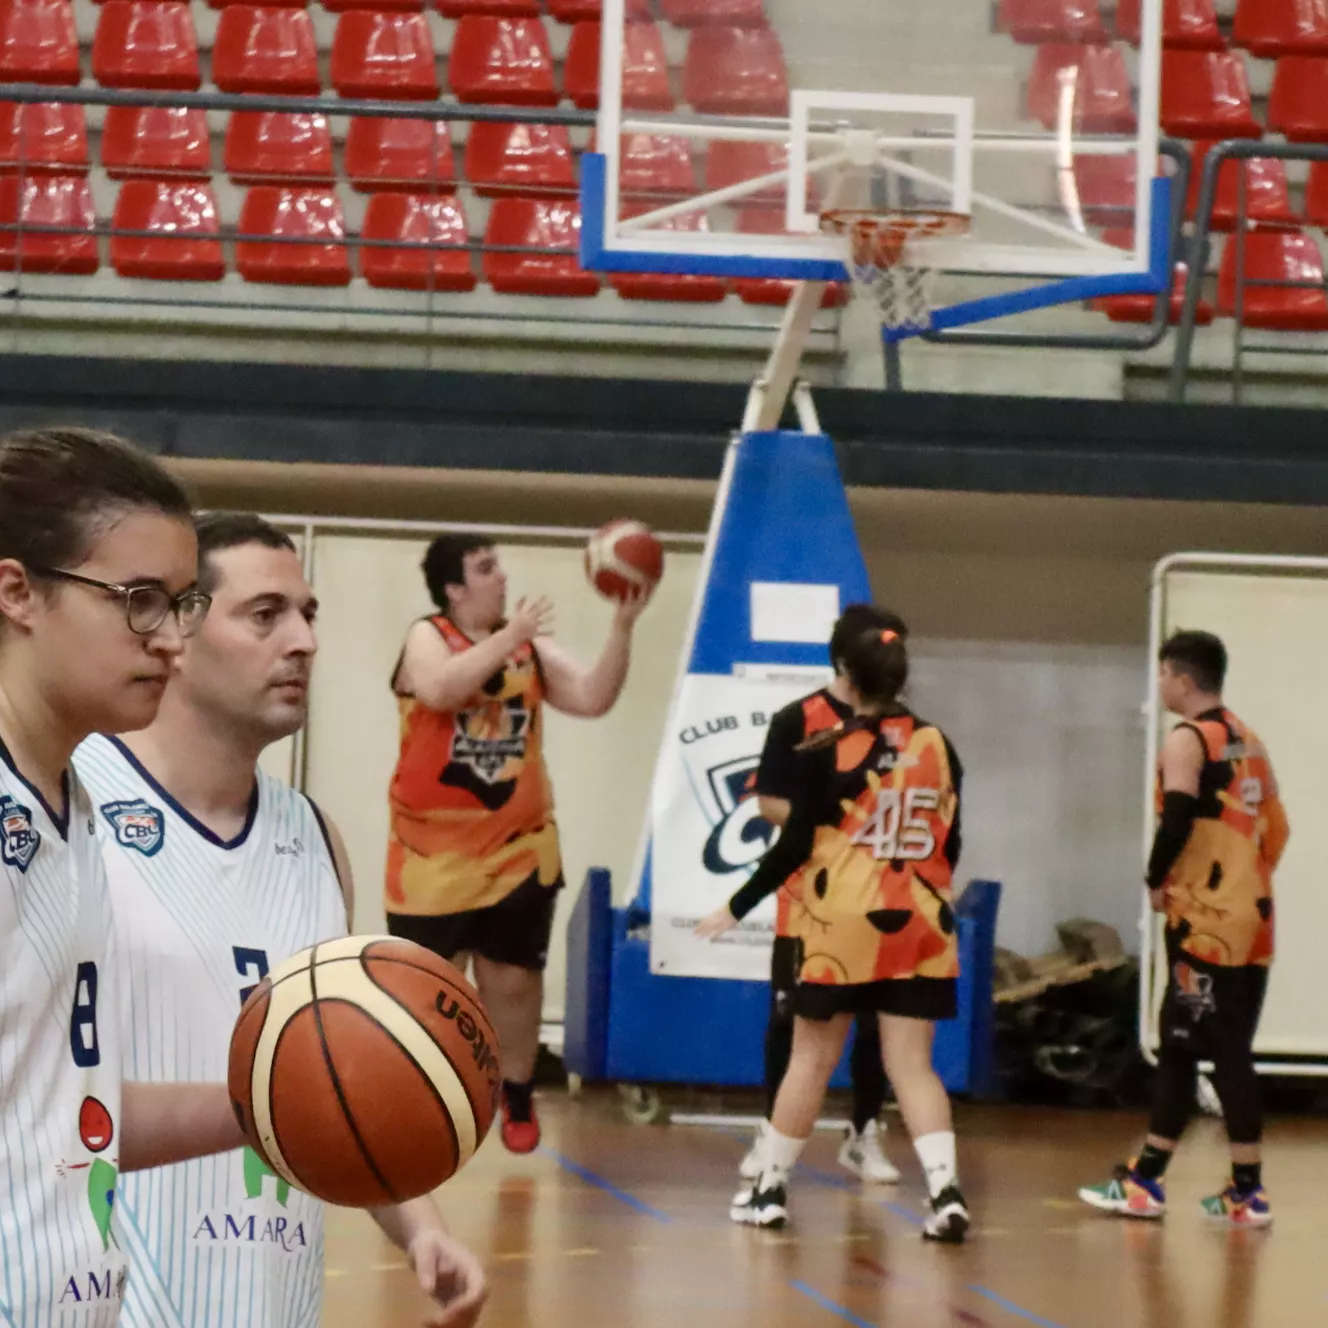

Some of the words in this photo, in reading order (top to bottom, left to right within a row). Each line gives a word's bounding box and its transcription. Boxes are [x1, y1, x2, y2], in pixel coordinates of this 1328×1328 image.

[679, 714, 740, 745] CLUB
[850, 786, 940, 860] 45
[70, 960, 100, 1068] 8
[192, 1213, 308, 1252] AMARA
